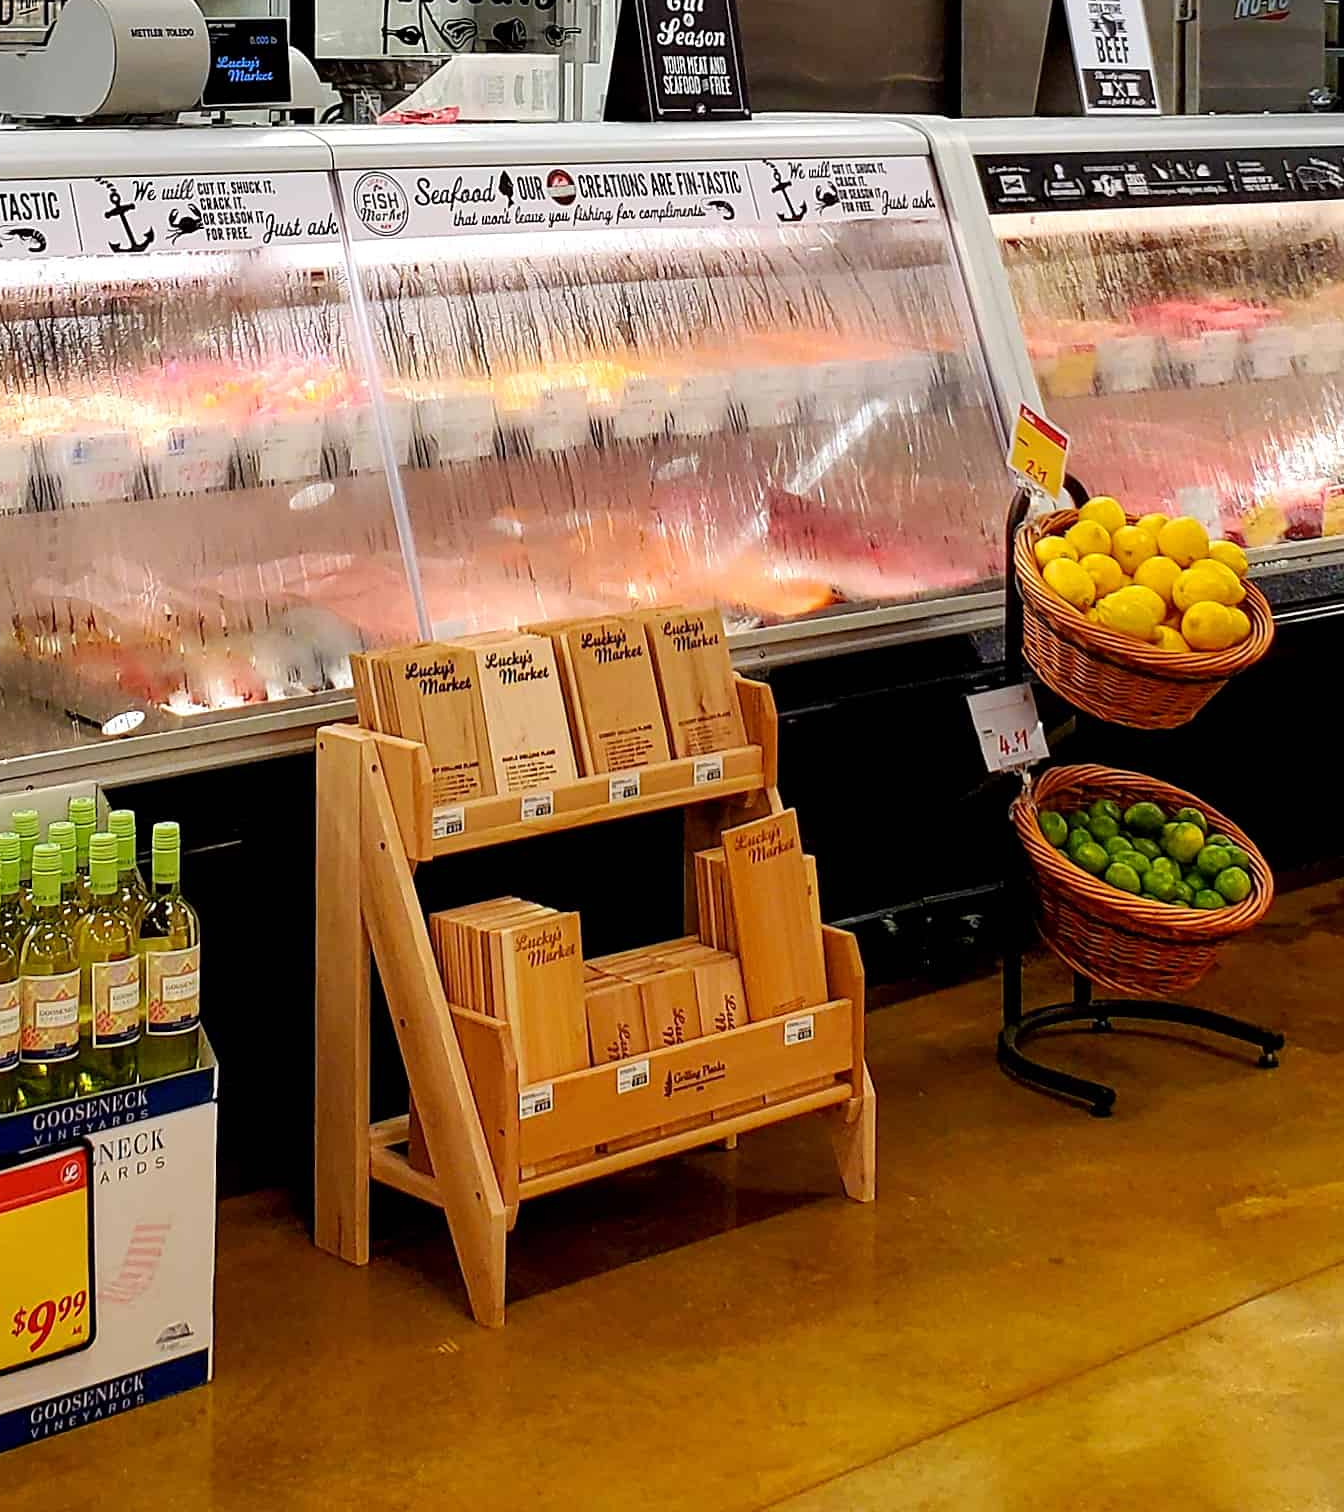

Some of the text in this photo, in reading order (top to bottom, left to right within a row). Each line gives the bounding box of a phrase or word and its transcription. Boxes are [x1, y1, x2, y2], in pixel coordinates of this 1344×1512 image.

[657, 18, 726, 48] Season
[1095, 37, 1128, 64] BEEF
[216, 56, 259, 72] Lucky's
[662, 56, 726, 75] YOUR MEAT AND
[227, 69, 273, 82] Market
[663, 76, 701, 95] SEAFOOD
[709, 76, 733, 96] FREE
[787, 162, 805, 179] We
[808, 161, 831, 179] will
[132, 180, 156, 203] We
[161, 178, 195, 202] will
[197, 181, 213, 197] CUT
[231, 180, 261, 196] SHUCK
[414, 170, 742, 211] Seafood OUR CREATIONS ARE FIN-TASTIC
[201, 197, 227, 211] CRACK
[363, 191, 400, 211] FISH
[881, 190, 908, 215] Just
[203, 210, 264, 225] OR SEASON IT
[360, 207, 405, 223] Market
[453, 210, 478, 227] that
[515, 208, 546, 224] leave
[548, 210, 570, 228] you
[573, 204, 613, 226] fishing
[616, 204, 637, 224] for
[639, 202, 706, 222] compliments.
[207, 228, 225, 242] FOR
[263, 213, 302, 243] Just
[663, 618, 704, 636] Lucky's
[581, 628, 626, 649] Lucky's
[674, 633, 719, 652] Market
[486, 649, 533, 669] Lucky's
[595, 646, 642, 664] Market
[405, 660, 455, 680] Lucky's
[499, 666, 549, 684] Market
[419, 677, 472, 695] Market
[999, 734, 1010, 755] 4
[515, 926, 562, 952] Lucky's
[528, 943, 575, 967] Market
[33, 1088, 148, 1131] GOOSENECK
[34, 1109, 149, 1145] VINEYARDS
[30, 1372, 144, 1424] GOOSENECK
[30, 1394, 145, 1438] VINEYARDS
